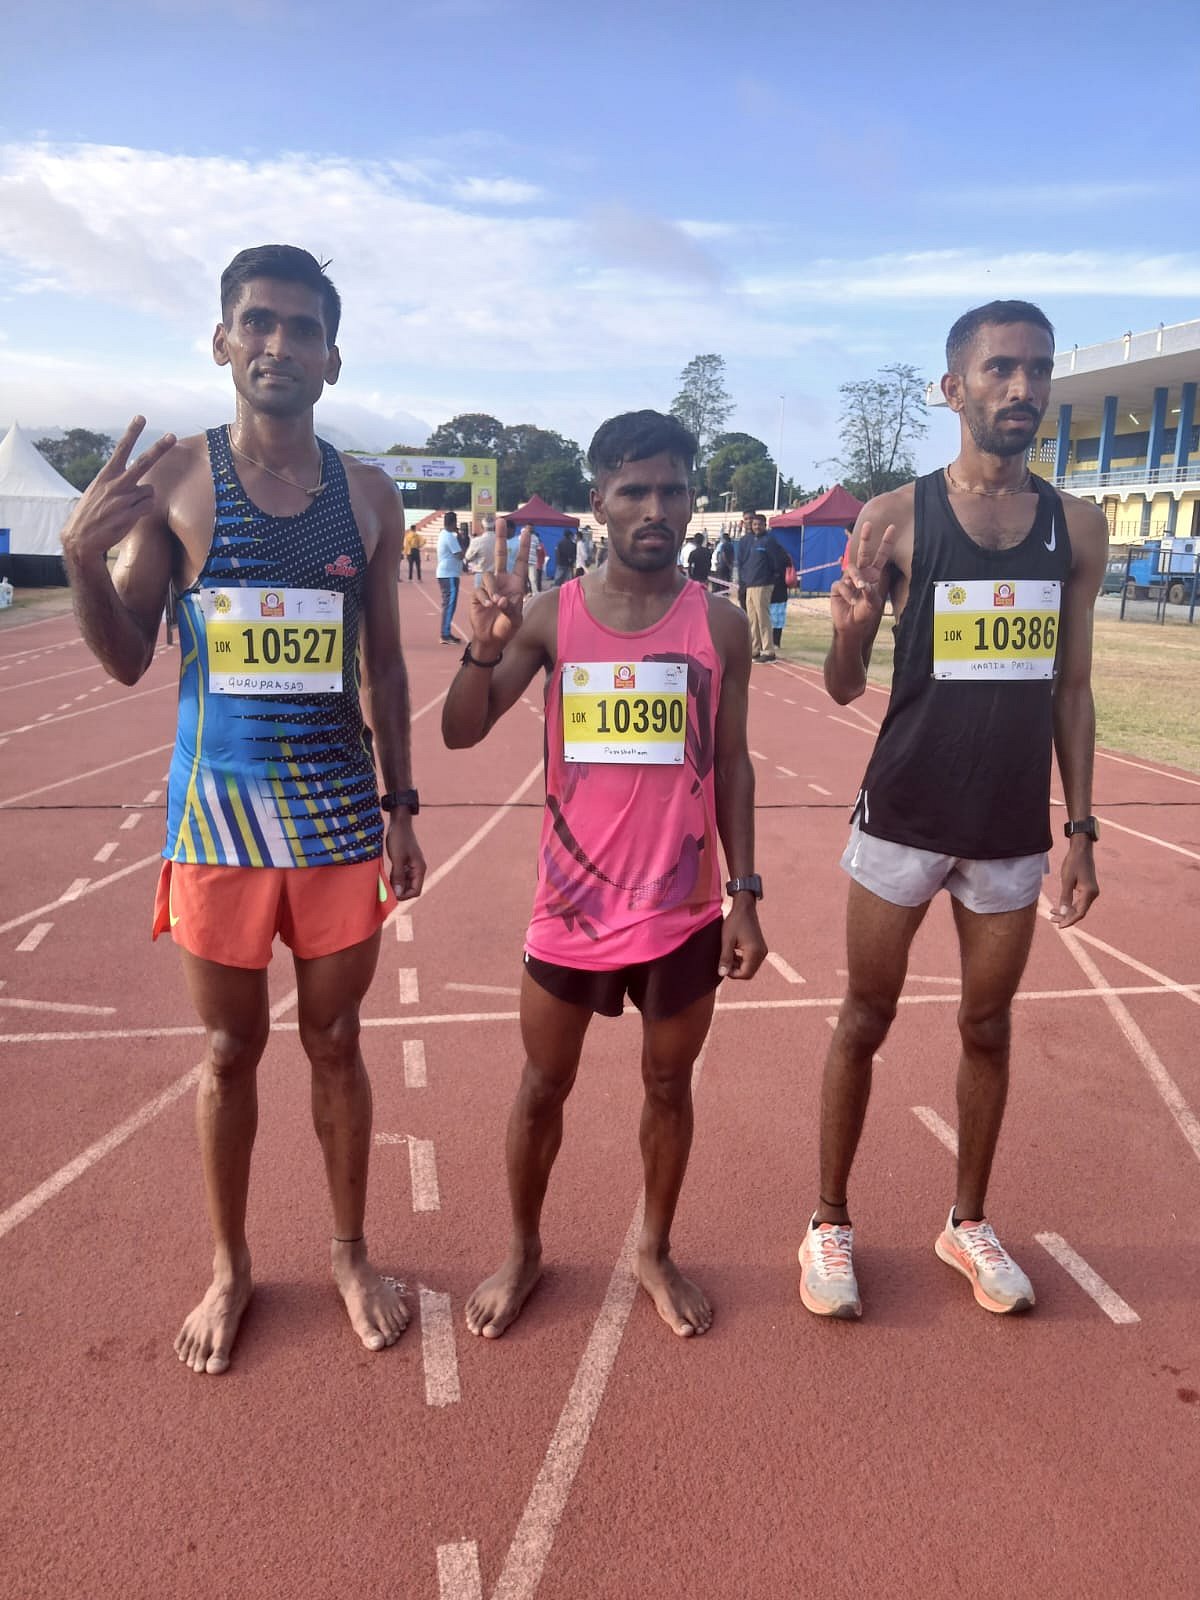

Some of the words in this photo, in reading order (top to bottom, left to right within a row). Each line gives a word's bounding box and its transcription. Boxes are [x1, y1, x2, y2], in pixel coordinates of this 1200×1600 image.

[215, 641, 231, 653] 10K
[242, 628, 337, 664] 10527
[943, 630, 962, 642] 10K
[974, 616, 1056, 651] 10386
[572, 712, 587, 723] 10K
[597, 699, 683, 733] 10390
